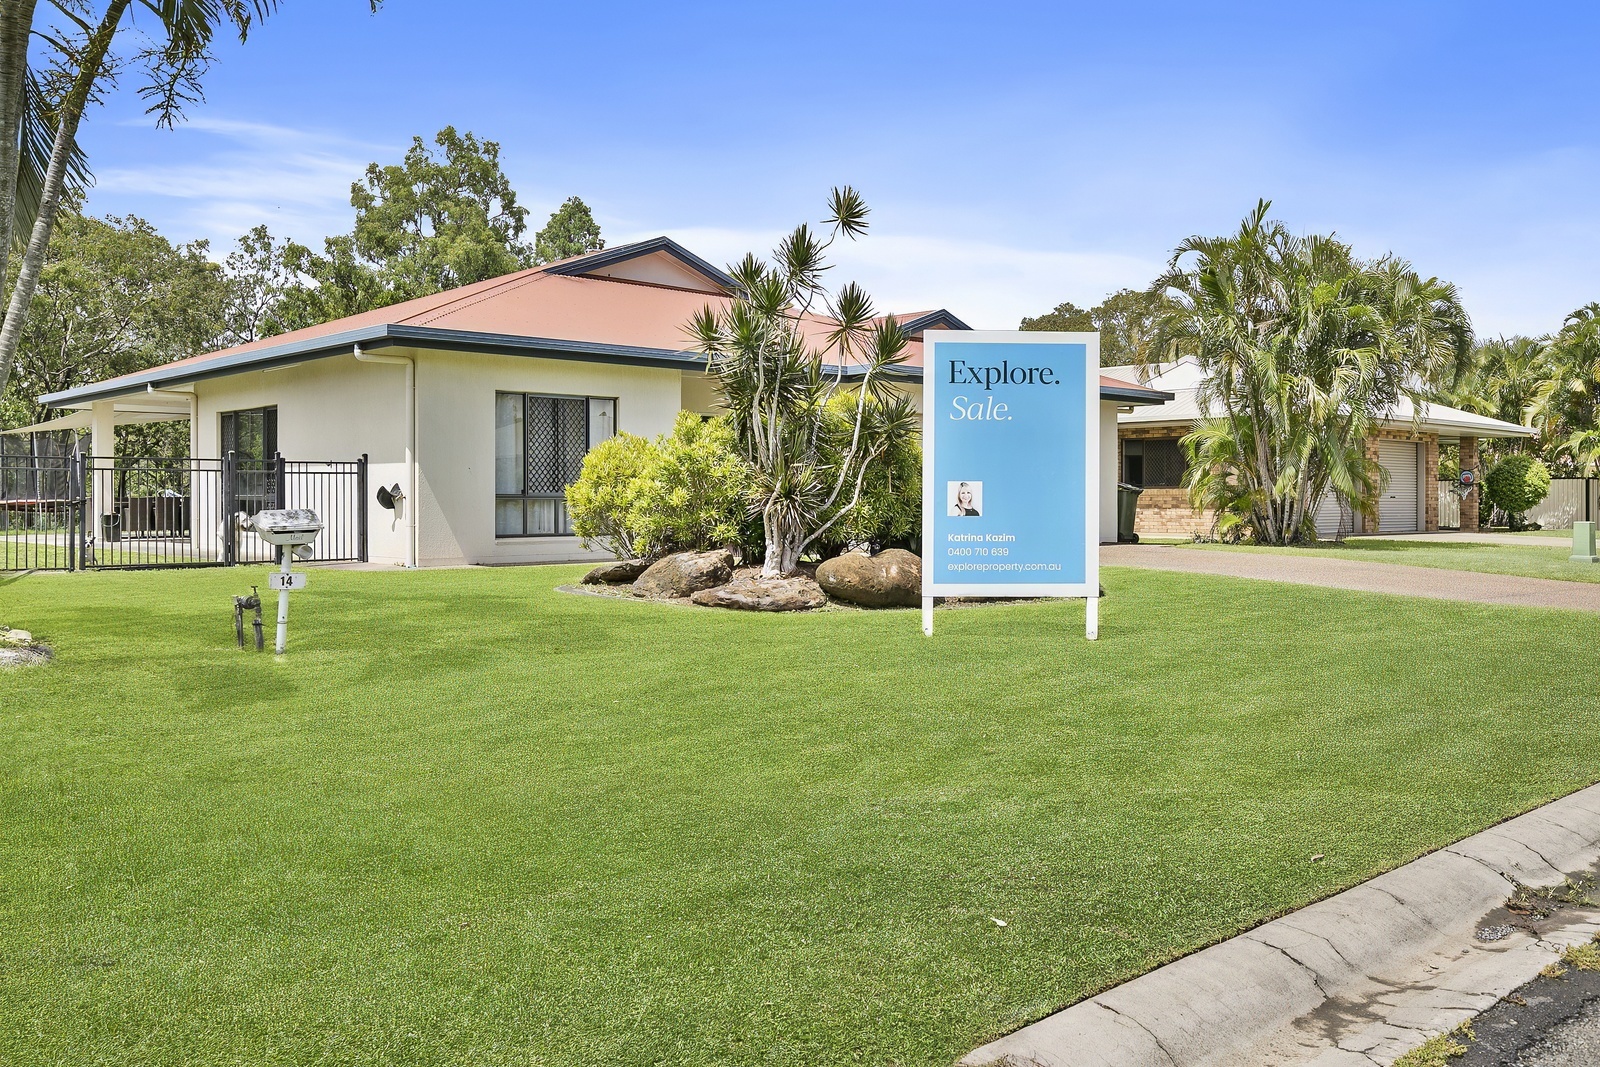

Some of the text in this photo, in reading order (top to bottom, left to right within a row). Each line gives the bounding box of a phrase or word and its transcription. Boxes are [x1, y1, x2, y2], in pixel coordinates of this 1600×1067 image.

[949, 360, 1060, 390] Explore.
[950, 395, 1013, 421] Sale.
[948, 533, 1015, 542] Katrina Kazim
[947, 547, 1009, 556] 0400 710 639
[947, 562, 1061, 573] exploreproperty.com.au
[280, 576, 293, 586] 14
